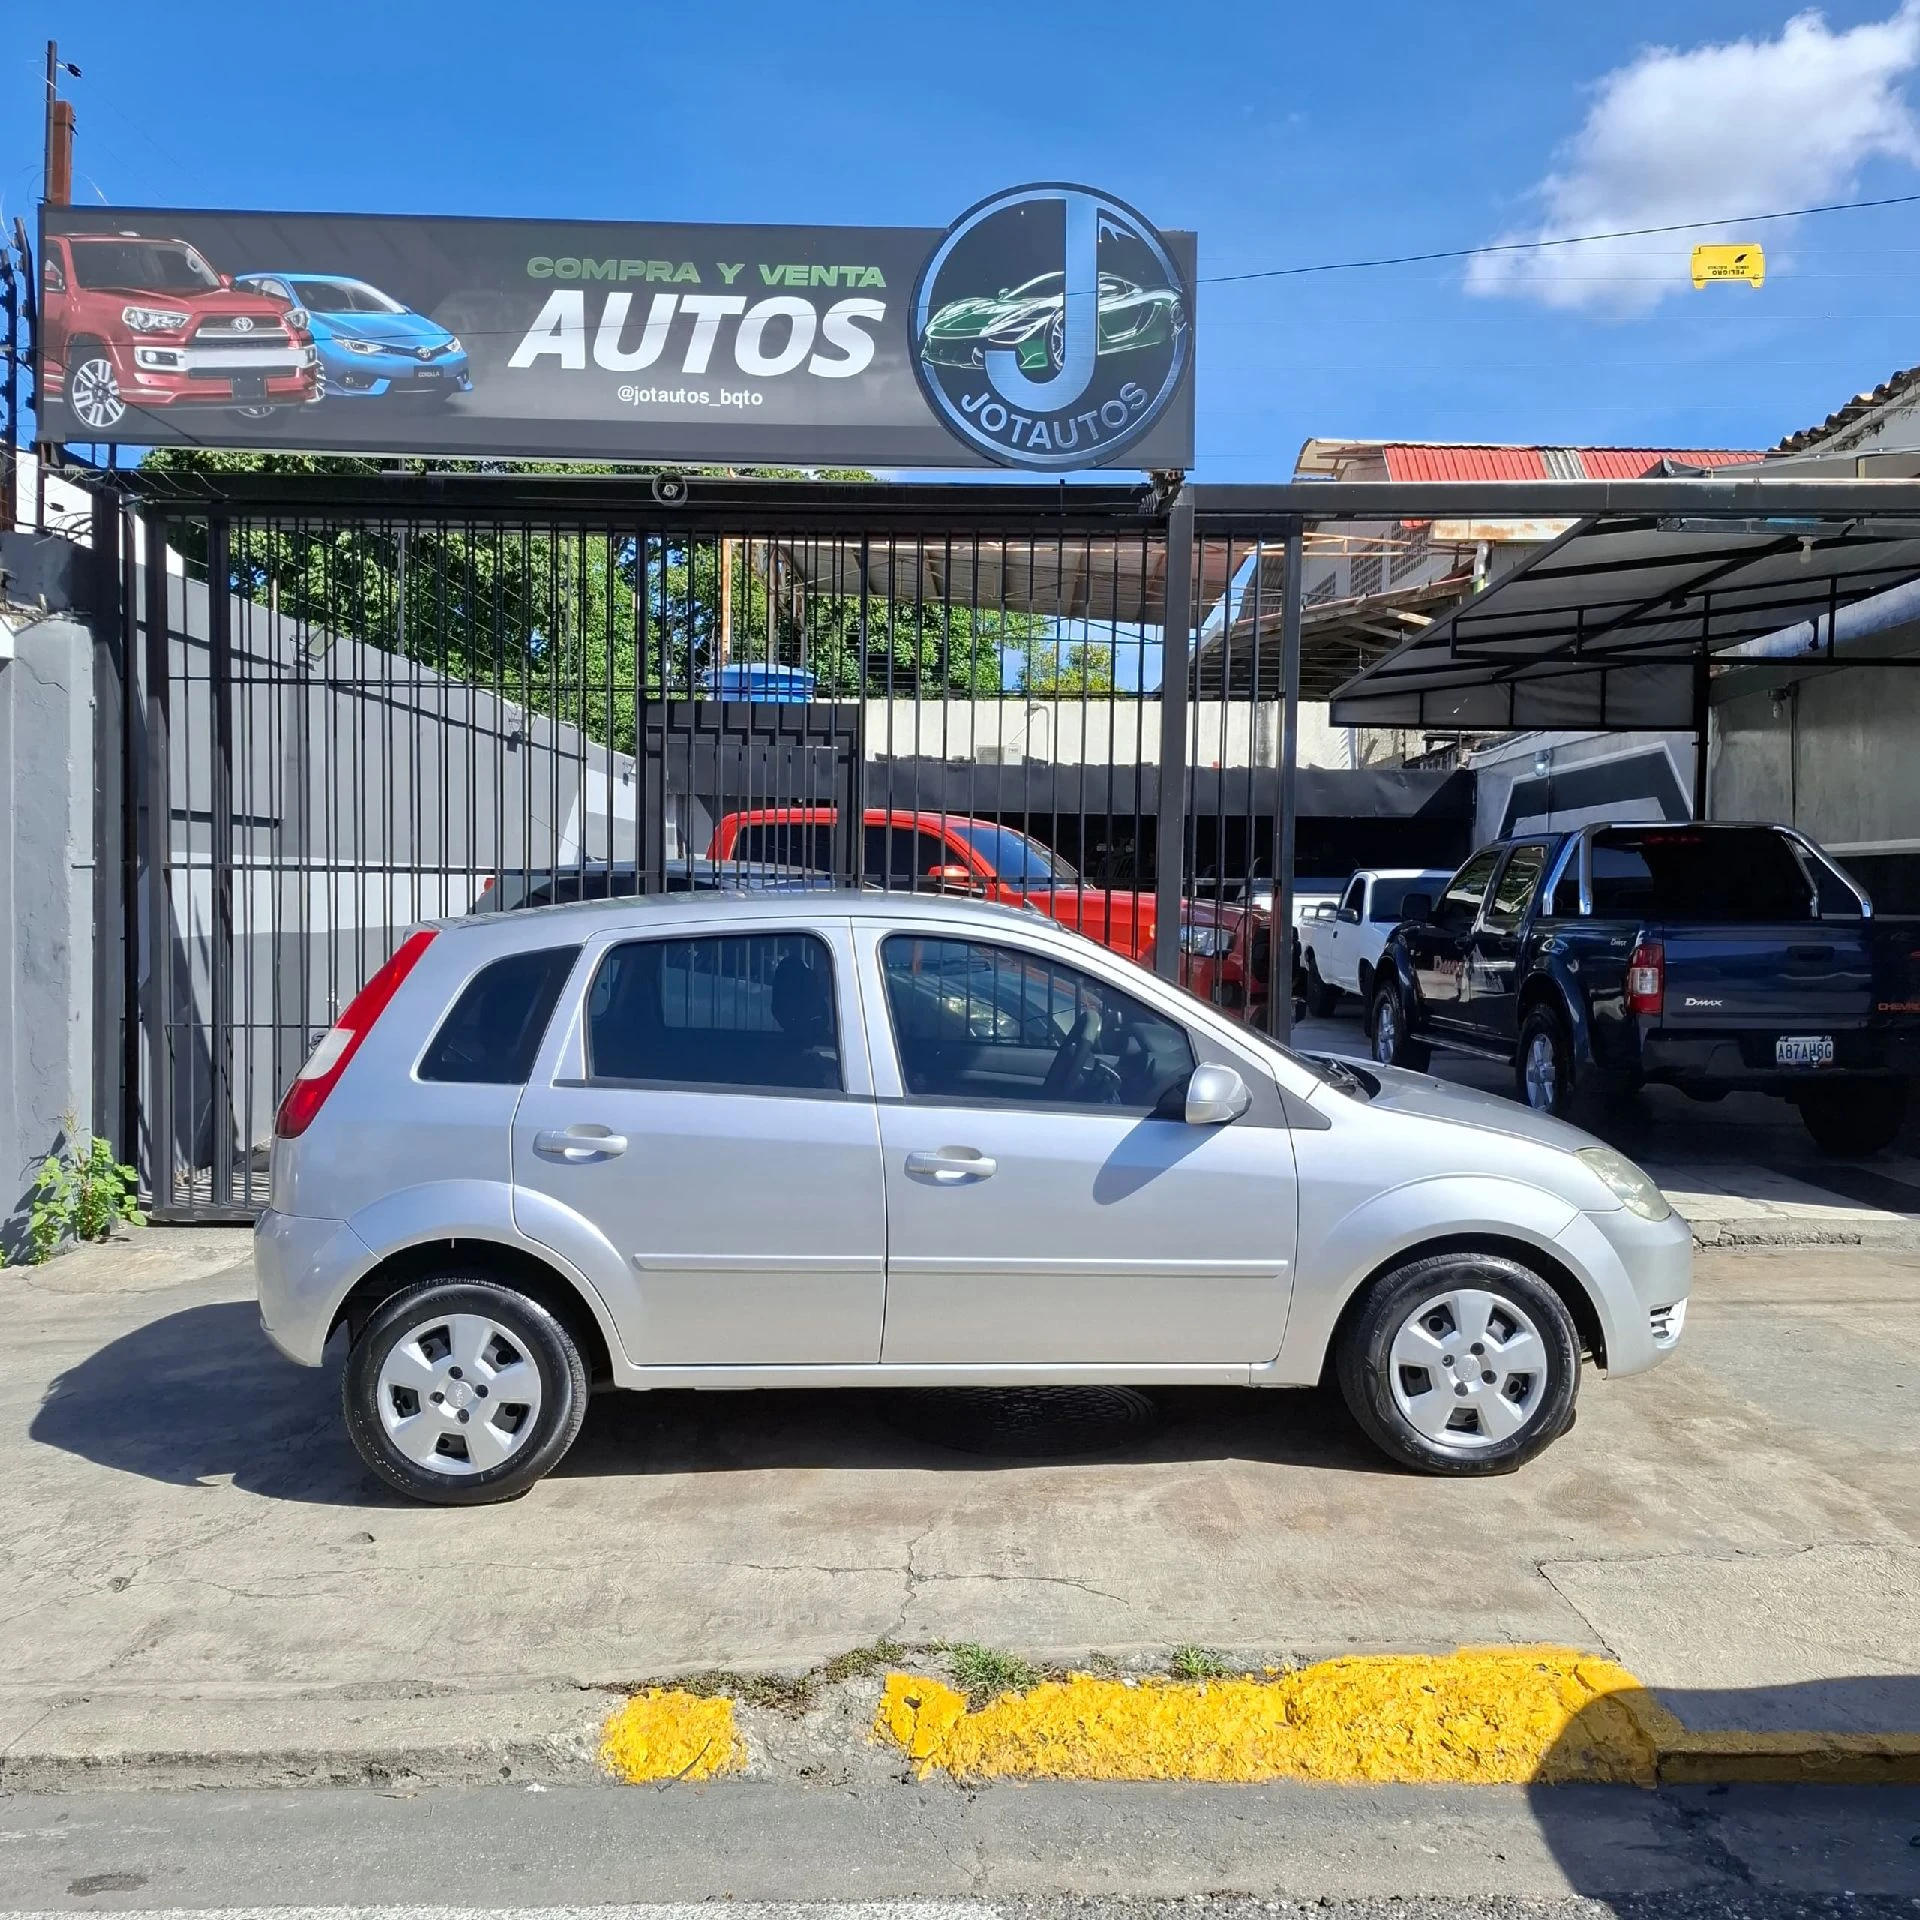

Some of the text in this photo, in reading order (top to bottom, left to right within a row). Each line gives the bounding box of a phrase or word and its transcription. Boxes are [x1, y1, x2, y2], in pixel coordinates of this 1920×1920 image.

[526, 256, 888, 288] COMPRA Y VENTA
[507, 289, 887, 379] AUTOS
[617, 384, 764, 409] @jotautos_bqto
[960, 381, 1149, 450] JOTAUTOS
